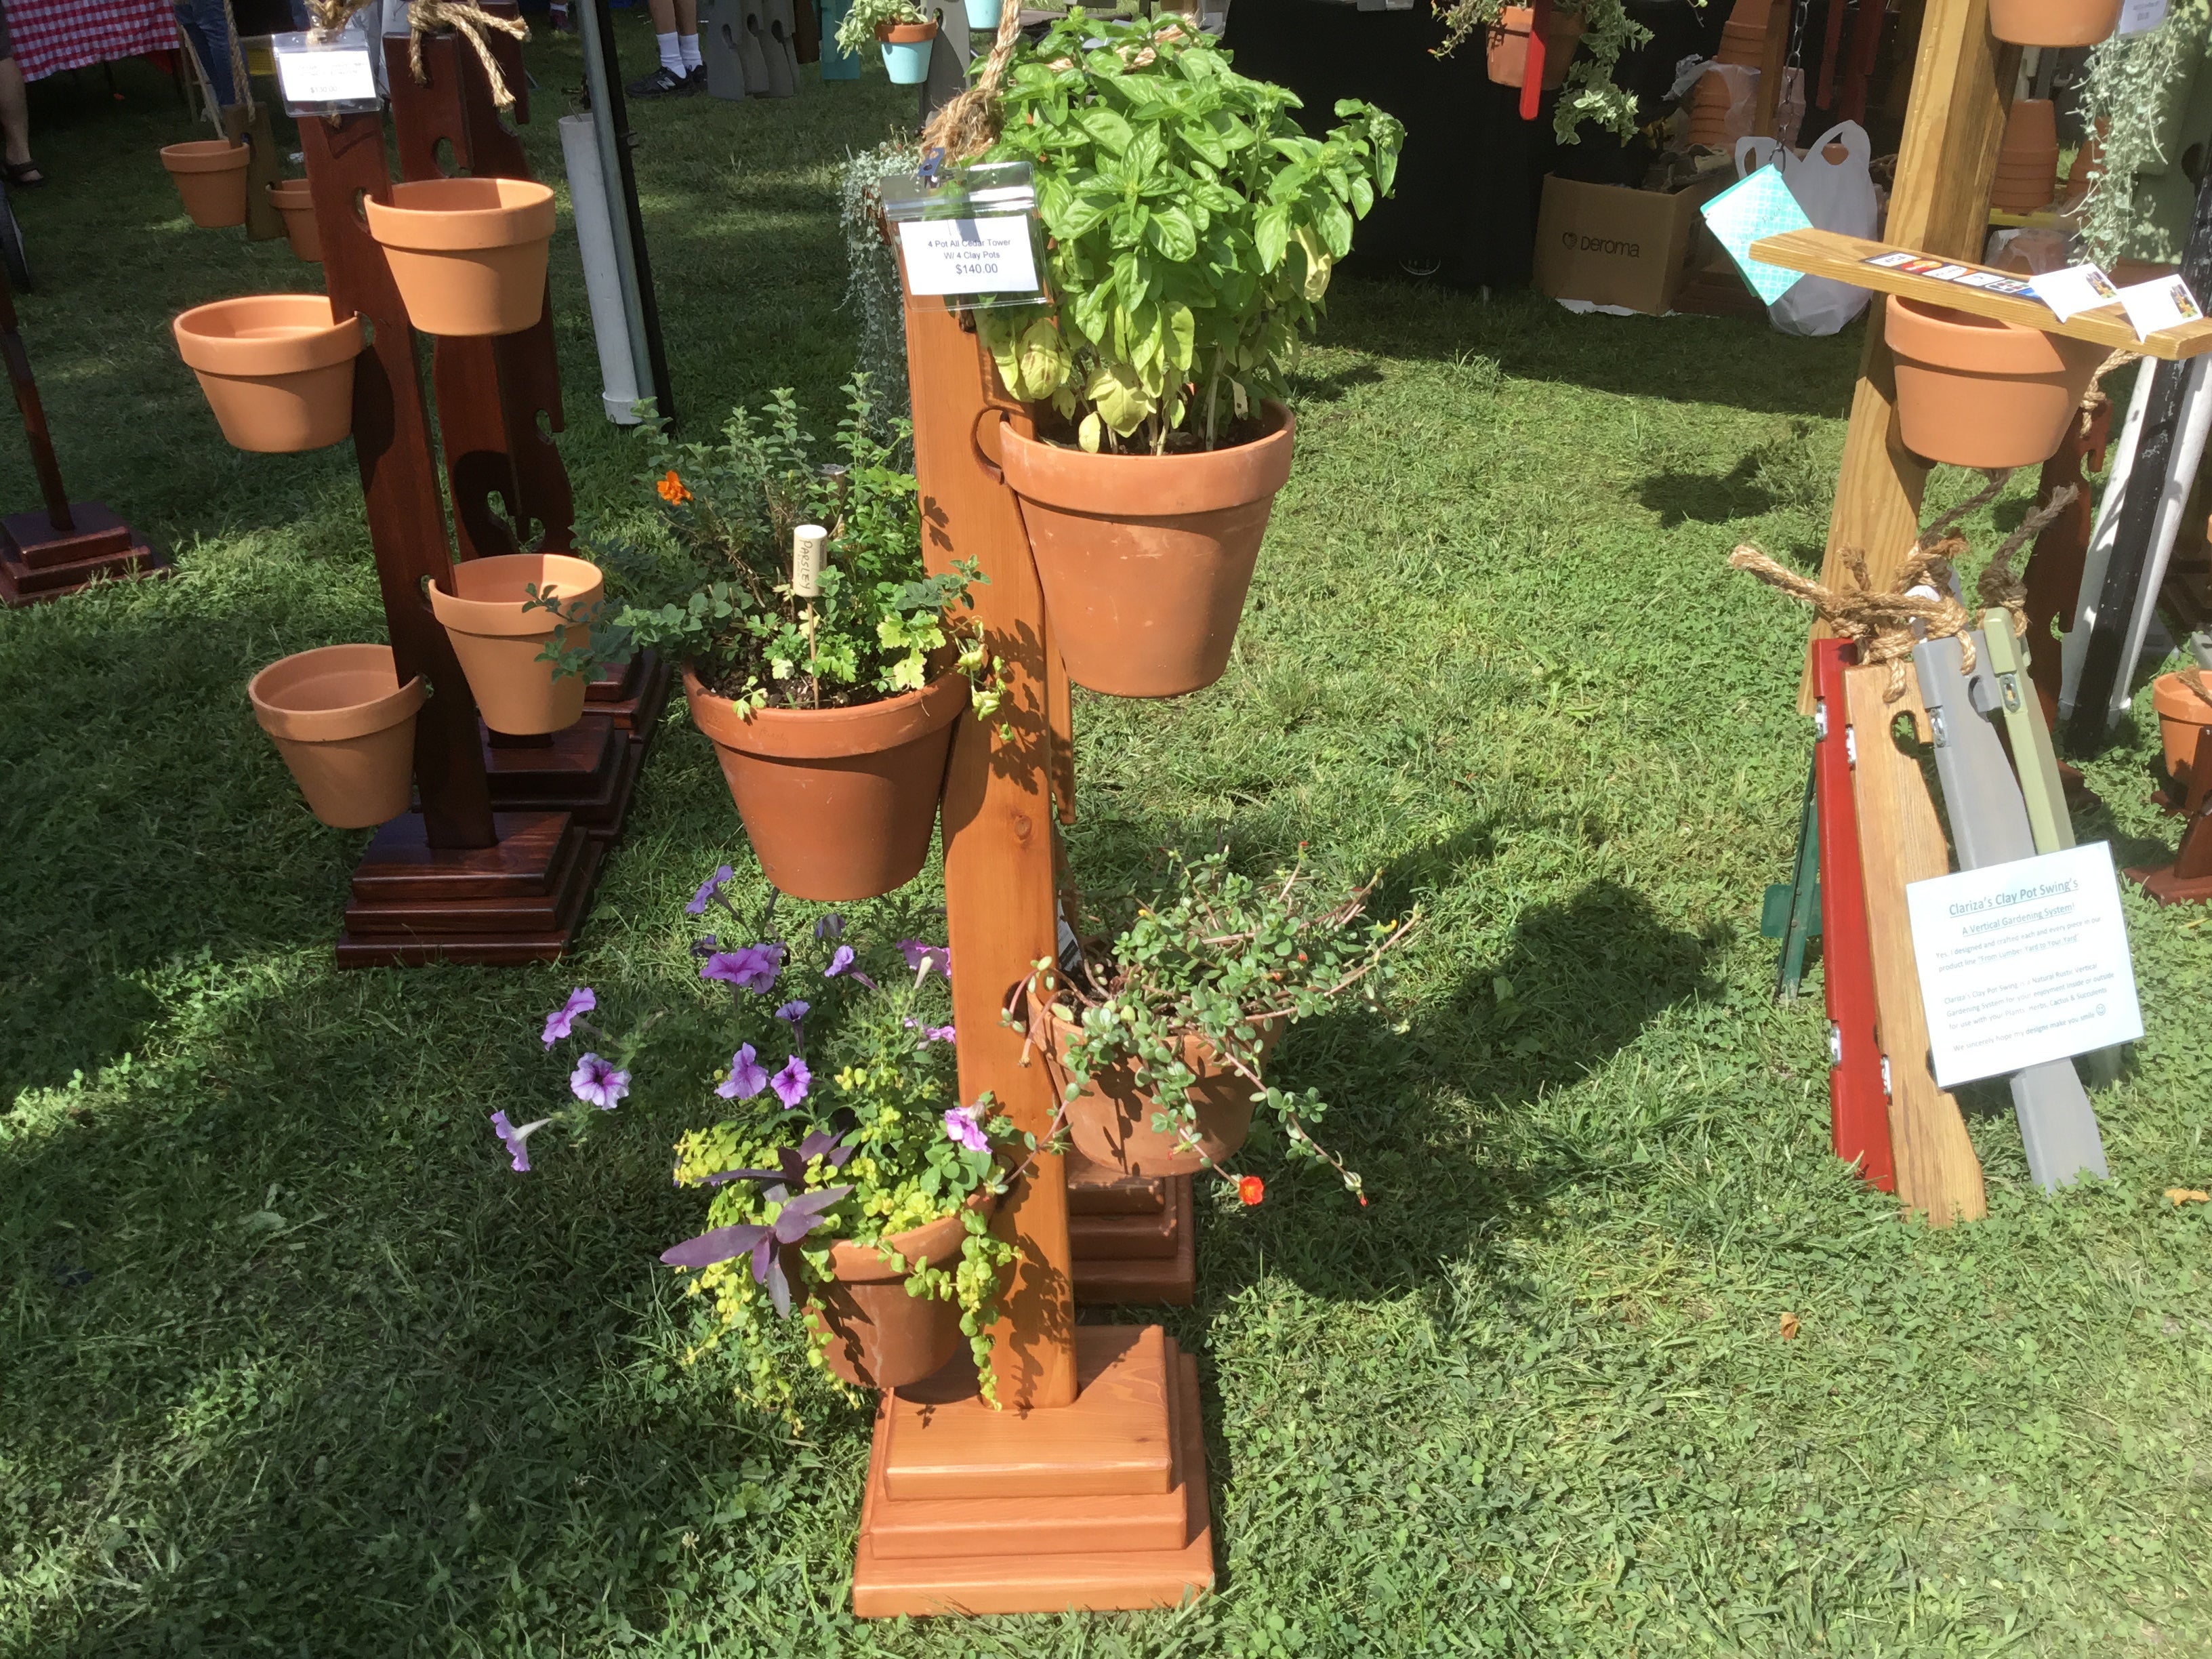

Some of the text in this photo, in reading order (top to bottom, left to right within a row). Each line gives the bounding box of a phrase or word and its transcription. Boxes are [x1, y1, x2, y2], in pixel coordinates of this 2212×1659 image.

[935, 240, 949, 248] Pot
[962, 239, 985, 247] Cedar
[964, 251, 981, 260] Clay
[983, 251, 1000, 259] Pots
[956, 263, 998, 275] $140.00
[800, 540, 813, 589] PARSLEY
[1948, 877, 2078, 916] Clariza's Clay Pot Swing's
[1969, 918, 2001, 933] Vertical
[2001, 909, 2044, 928] Gardening
[1954, 943, 1983, 956] designed
[1983, 939, 1996, 948] and
[1996, 935, 2020, 945] crafted
[2020, 930, 2036, 939] each
[2036, 927, 2048, 936] and
[2049, 924, 2066, 933] every
[2066, 920, 2083, 930] piece
[1938, 960, 1964, 973] product
[1971, 989, 1986, 998] Clay
[1986, 986, 1998, 994] Pot
[2032, 972, 2055, 983] Natural
[2074, 962, 2097, 973] Vertical
[1946, 1004, 1981, 1018] Gardening
[1981, 998, 2005, 1010] System
[2005, 996, 2015, 1004] for
[2093, 971, 2115, 983] outside
[1972, 1015, 1988, 1025] with
[2049, 996, 2070, 1006] Cactus
[1965, 1037, 1994, 1049] sincerely
[1995, 1033, 2012, 1042] hope
[2025, 1023, 2049, 1036] designs
[2049, 1019, 2066, 1029] make
[2067, 1017, 2079, 1025] you
